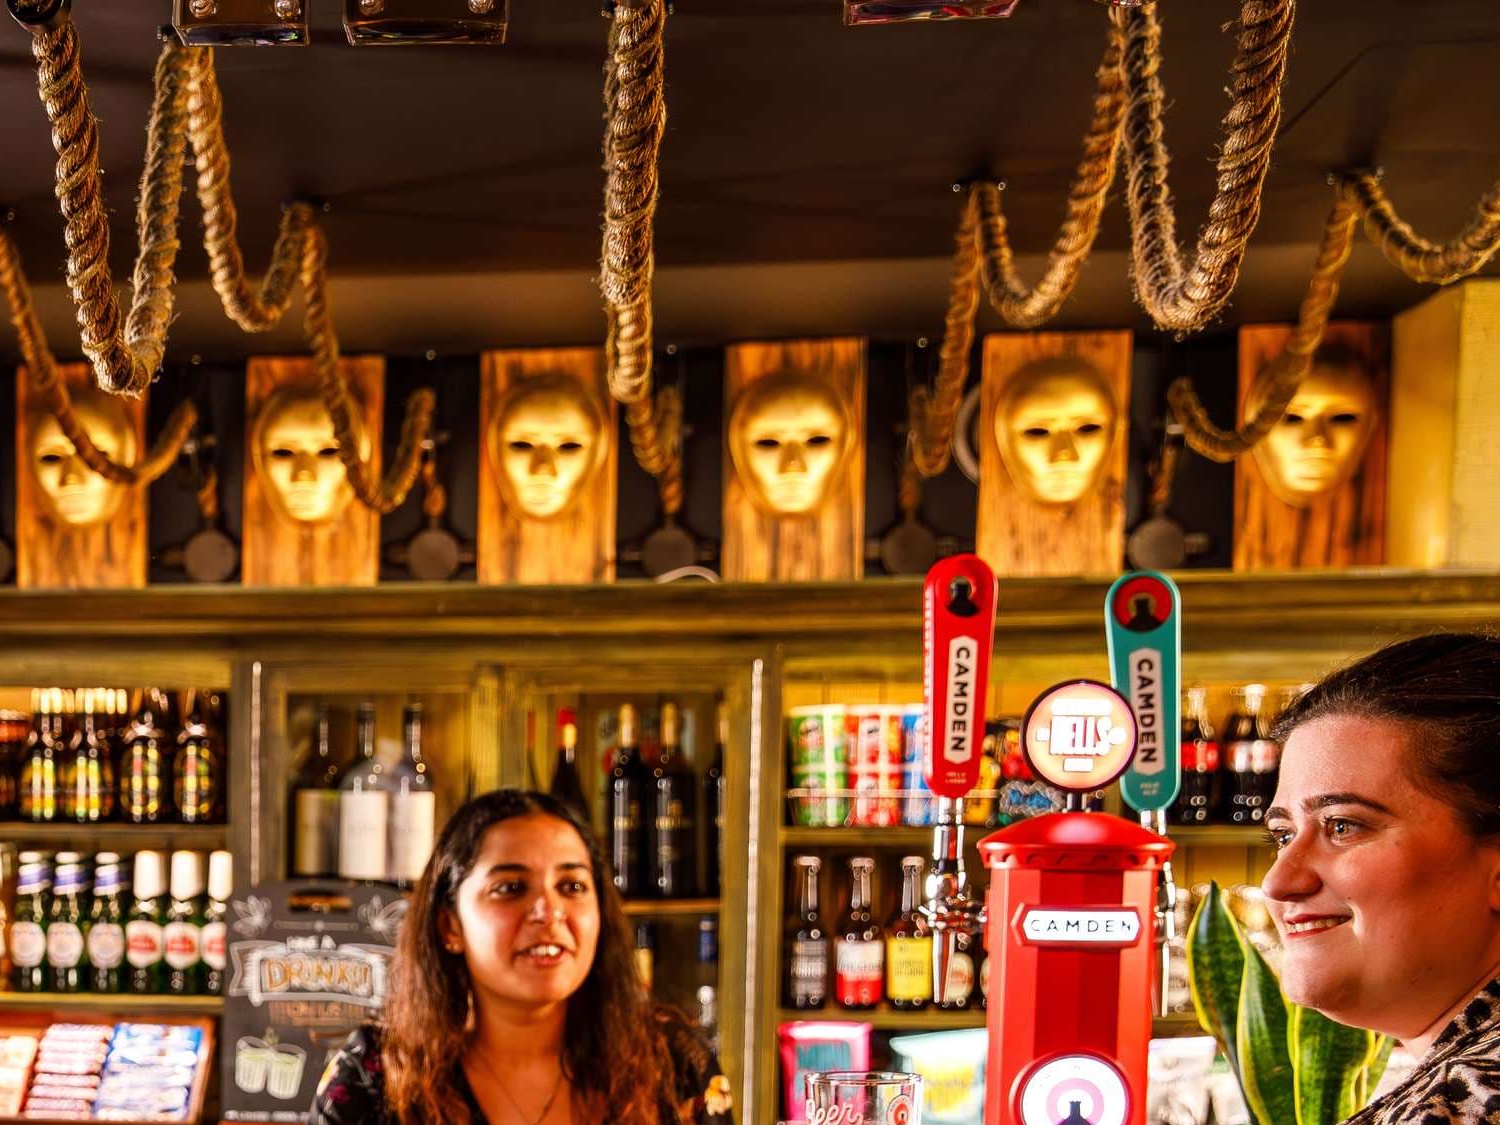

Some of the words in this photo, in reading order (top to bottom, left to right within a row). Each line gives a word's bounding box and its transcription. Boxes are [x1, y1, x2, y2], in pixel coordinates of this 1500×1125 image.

[951, 646, 970, 752] CAMDEN
[1137, 658, 1157, 763] CAMDEN
[1031, 919, 1131, 933] CAMDEN
